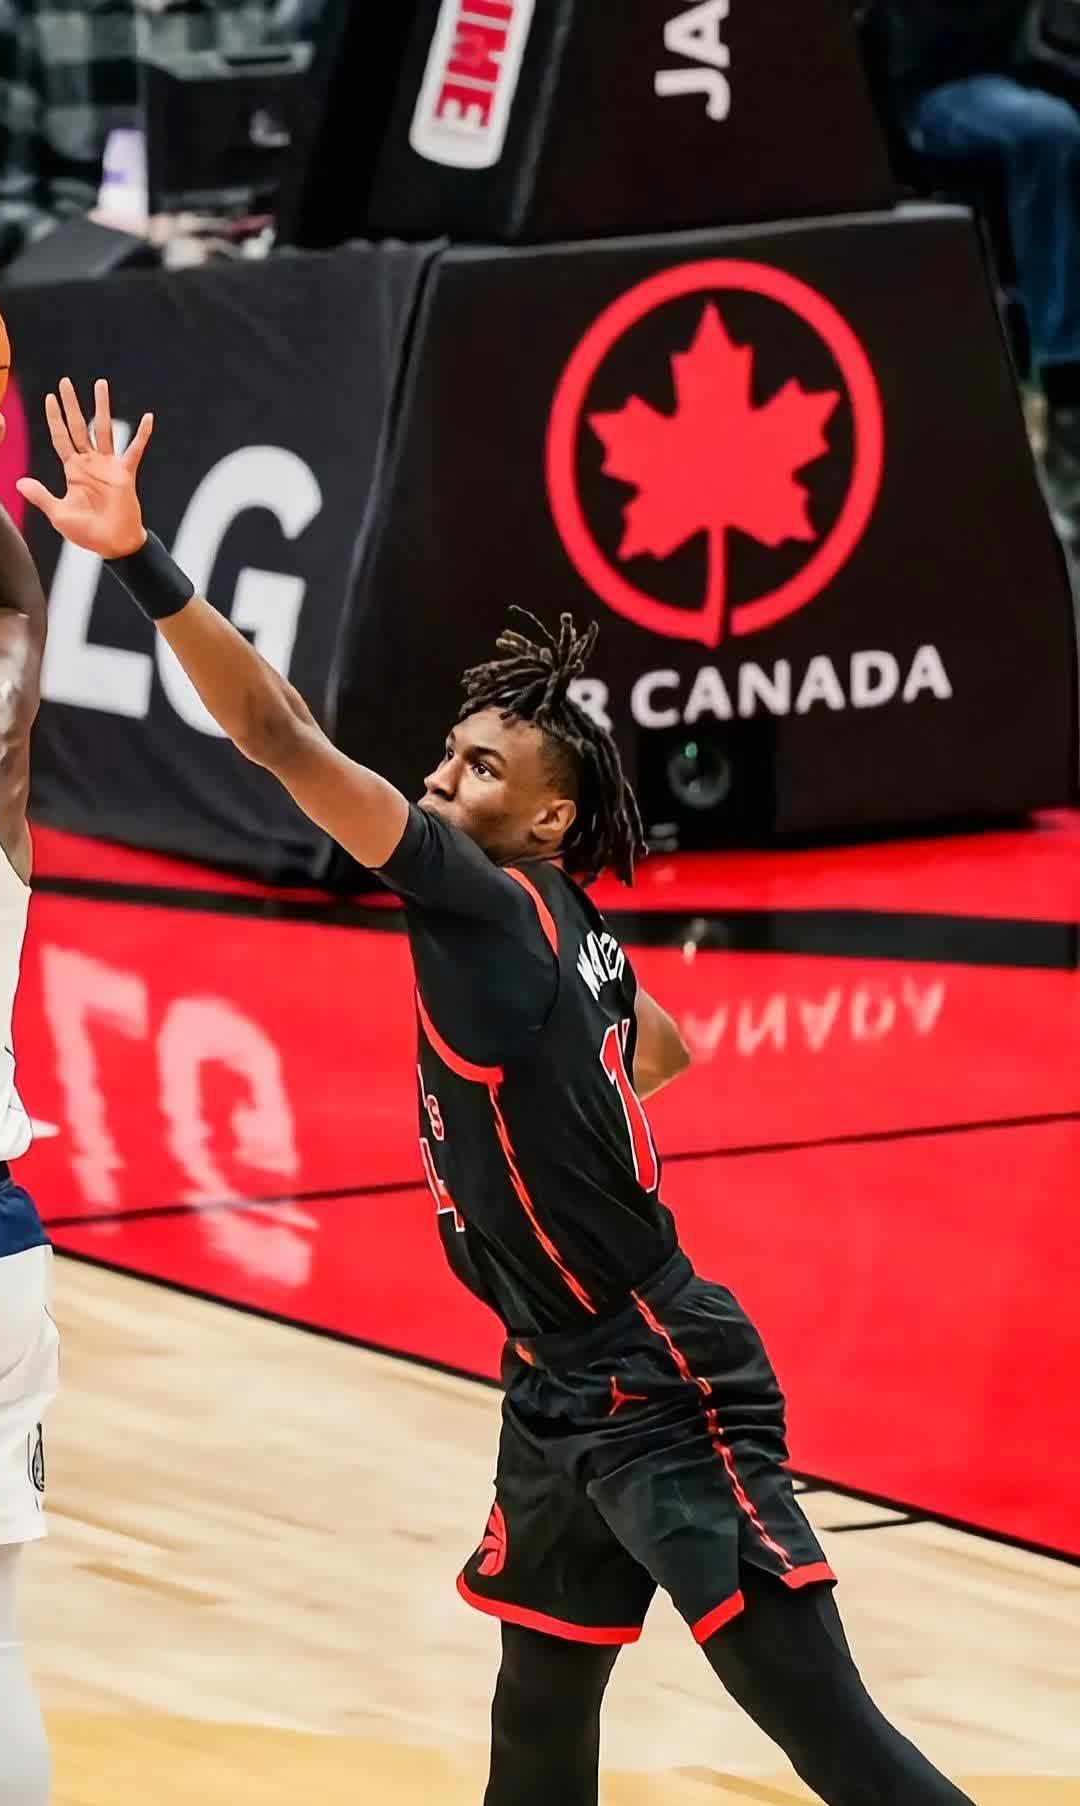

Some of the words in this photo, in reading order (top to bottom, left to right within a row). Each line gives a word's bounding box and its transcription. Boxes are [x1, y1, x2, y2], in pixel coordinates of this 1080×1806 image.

[654, 0, 732, 121] JA
[40, 417, 322, 738] LG
[631, 644, 953, 729] CANADA
[599, 1018, 658, 1193] 1
